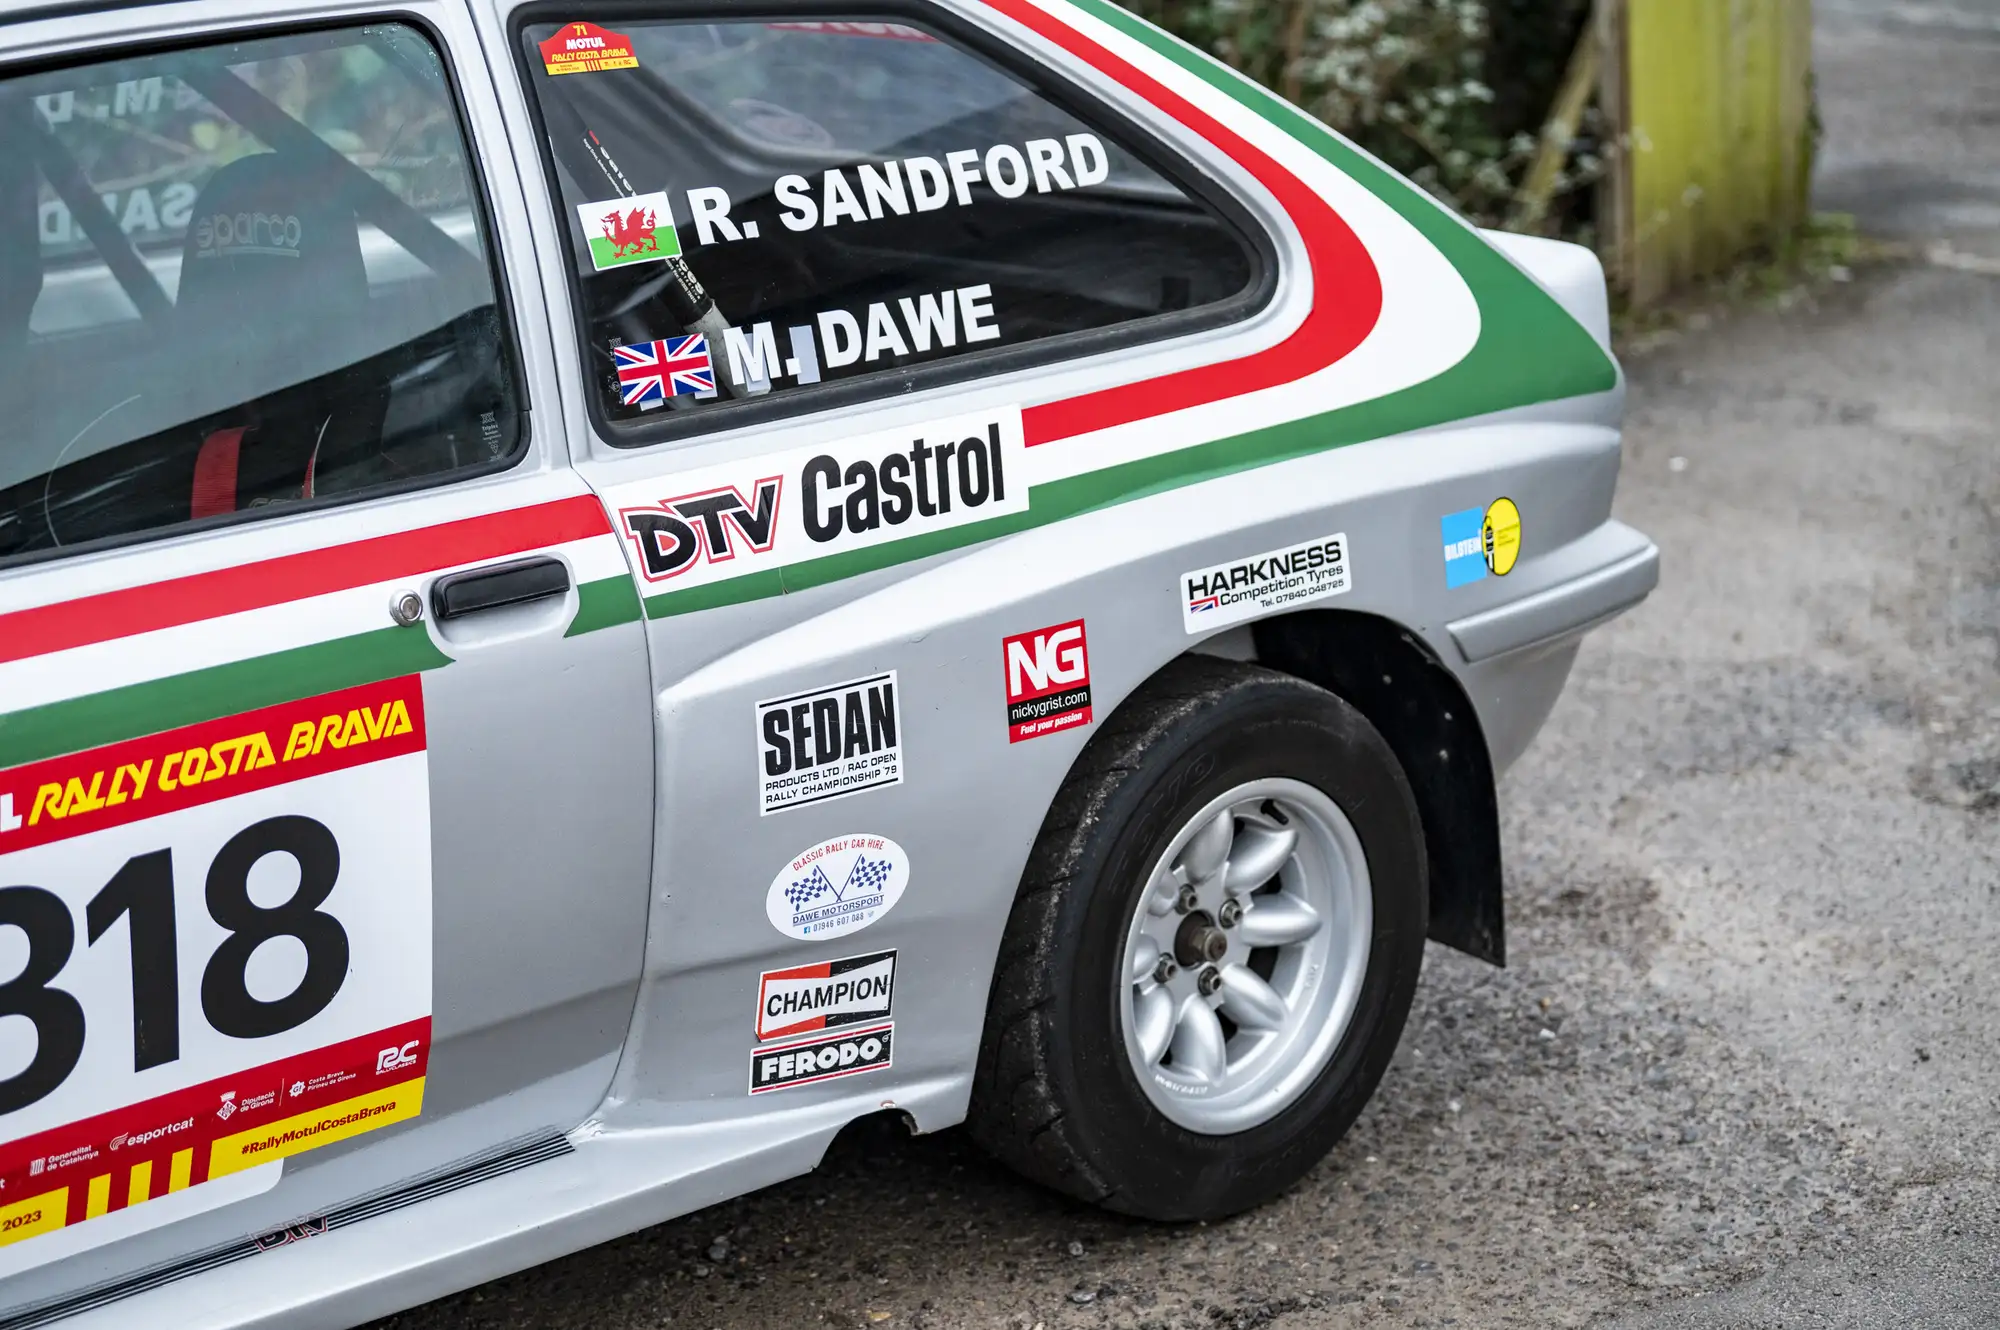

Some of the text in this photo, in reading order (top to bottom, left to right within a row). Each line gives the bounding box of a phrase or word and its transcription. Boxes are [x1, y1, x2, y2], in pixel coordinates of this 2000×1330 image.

[566, 37, 605, 50] MOTUL
[573, 25, 587, 35] 71
[552, 48, 628, 62] RALLY COSTA BRAVA
[686, 132, 1110, 246] R. SANDFORD
[198, 212, 300, 256] sparco
[722, 284, 1001, 385] M. DAWE
[621, 423, 1005, 580] DTV Castrol
[1188, 541, 1342, 600] HARKNESS
[1220, 565, 1344, 606] Competition Tyres
[1261, 599, 1275, 609] Tel.
[1276, 589, 1308, 604] 07840
[1007, 626, 1086, 697] NG
[1012, 691, 1088, 720] nickygrist.com
[763, 683, 897, 776] SEDAN
[1020, 712, 1083, 735] Fuel your passion
[27, 759, 153, 826] RALLY
[157, 731, 276, 792] COSTA
[283, 699, 413, 762] BRAVA
[765, 771, 820, 791] PRODUCTS
[822, 766, 840, 778] LTD
[848, 759, 868, 772] RAC
[870, 752, 897, 766] OPEN
[766, 789, 798, 804] RALLY
[802, 770, 881, 795] CHAMPIONSHIP
[792, 838, 885, 871] CLASSIC RALLY CAR HIRE
[792, 895, 885, 924] DAWE MOTORSPORT
[813, 921, 834, 932] 07946
[836, 916, 849, 926] 607
[767, 974, 889, 1017] CHAMPION
[761, 1037, 882, 1081] FERODO
[307, 1081, 328, 1091] Pirineu
[337, 1073, 357, 1083] Girona
[308, 1071, 344, 1085] Costa Brava
[241, 1090, 275, 1106] Diputació
[250, 1098, 274, 1110] Girona
[127, 1116, 194, 1147] esportcat
[241, 1101, 396, 1155] #RallyMotulCostaBrava
[47, 1150, 99, 1172] de Catalunya
[48, 1144, 92, 1163] Generalitat
[2, 1210, 42, 1232] 2023
